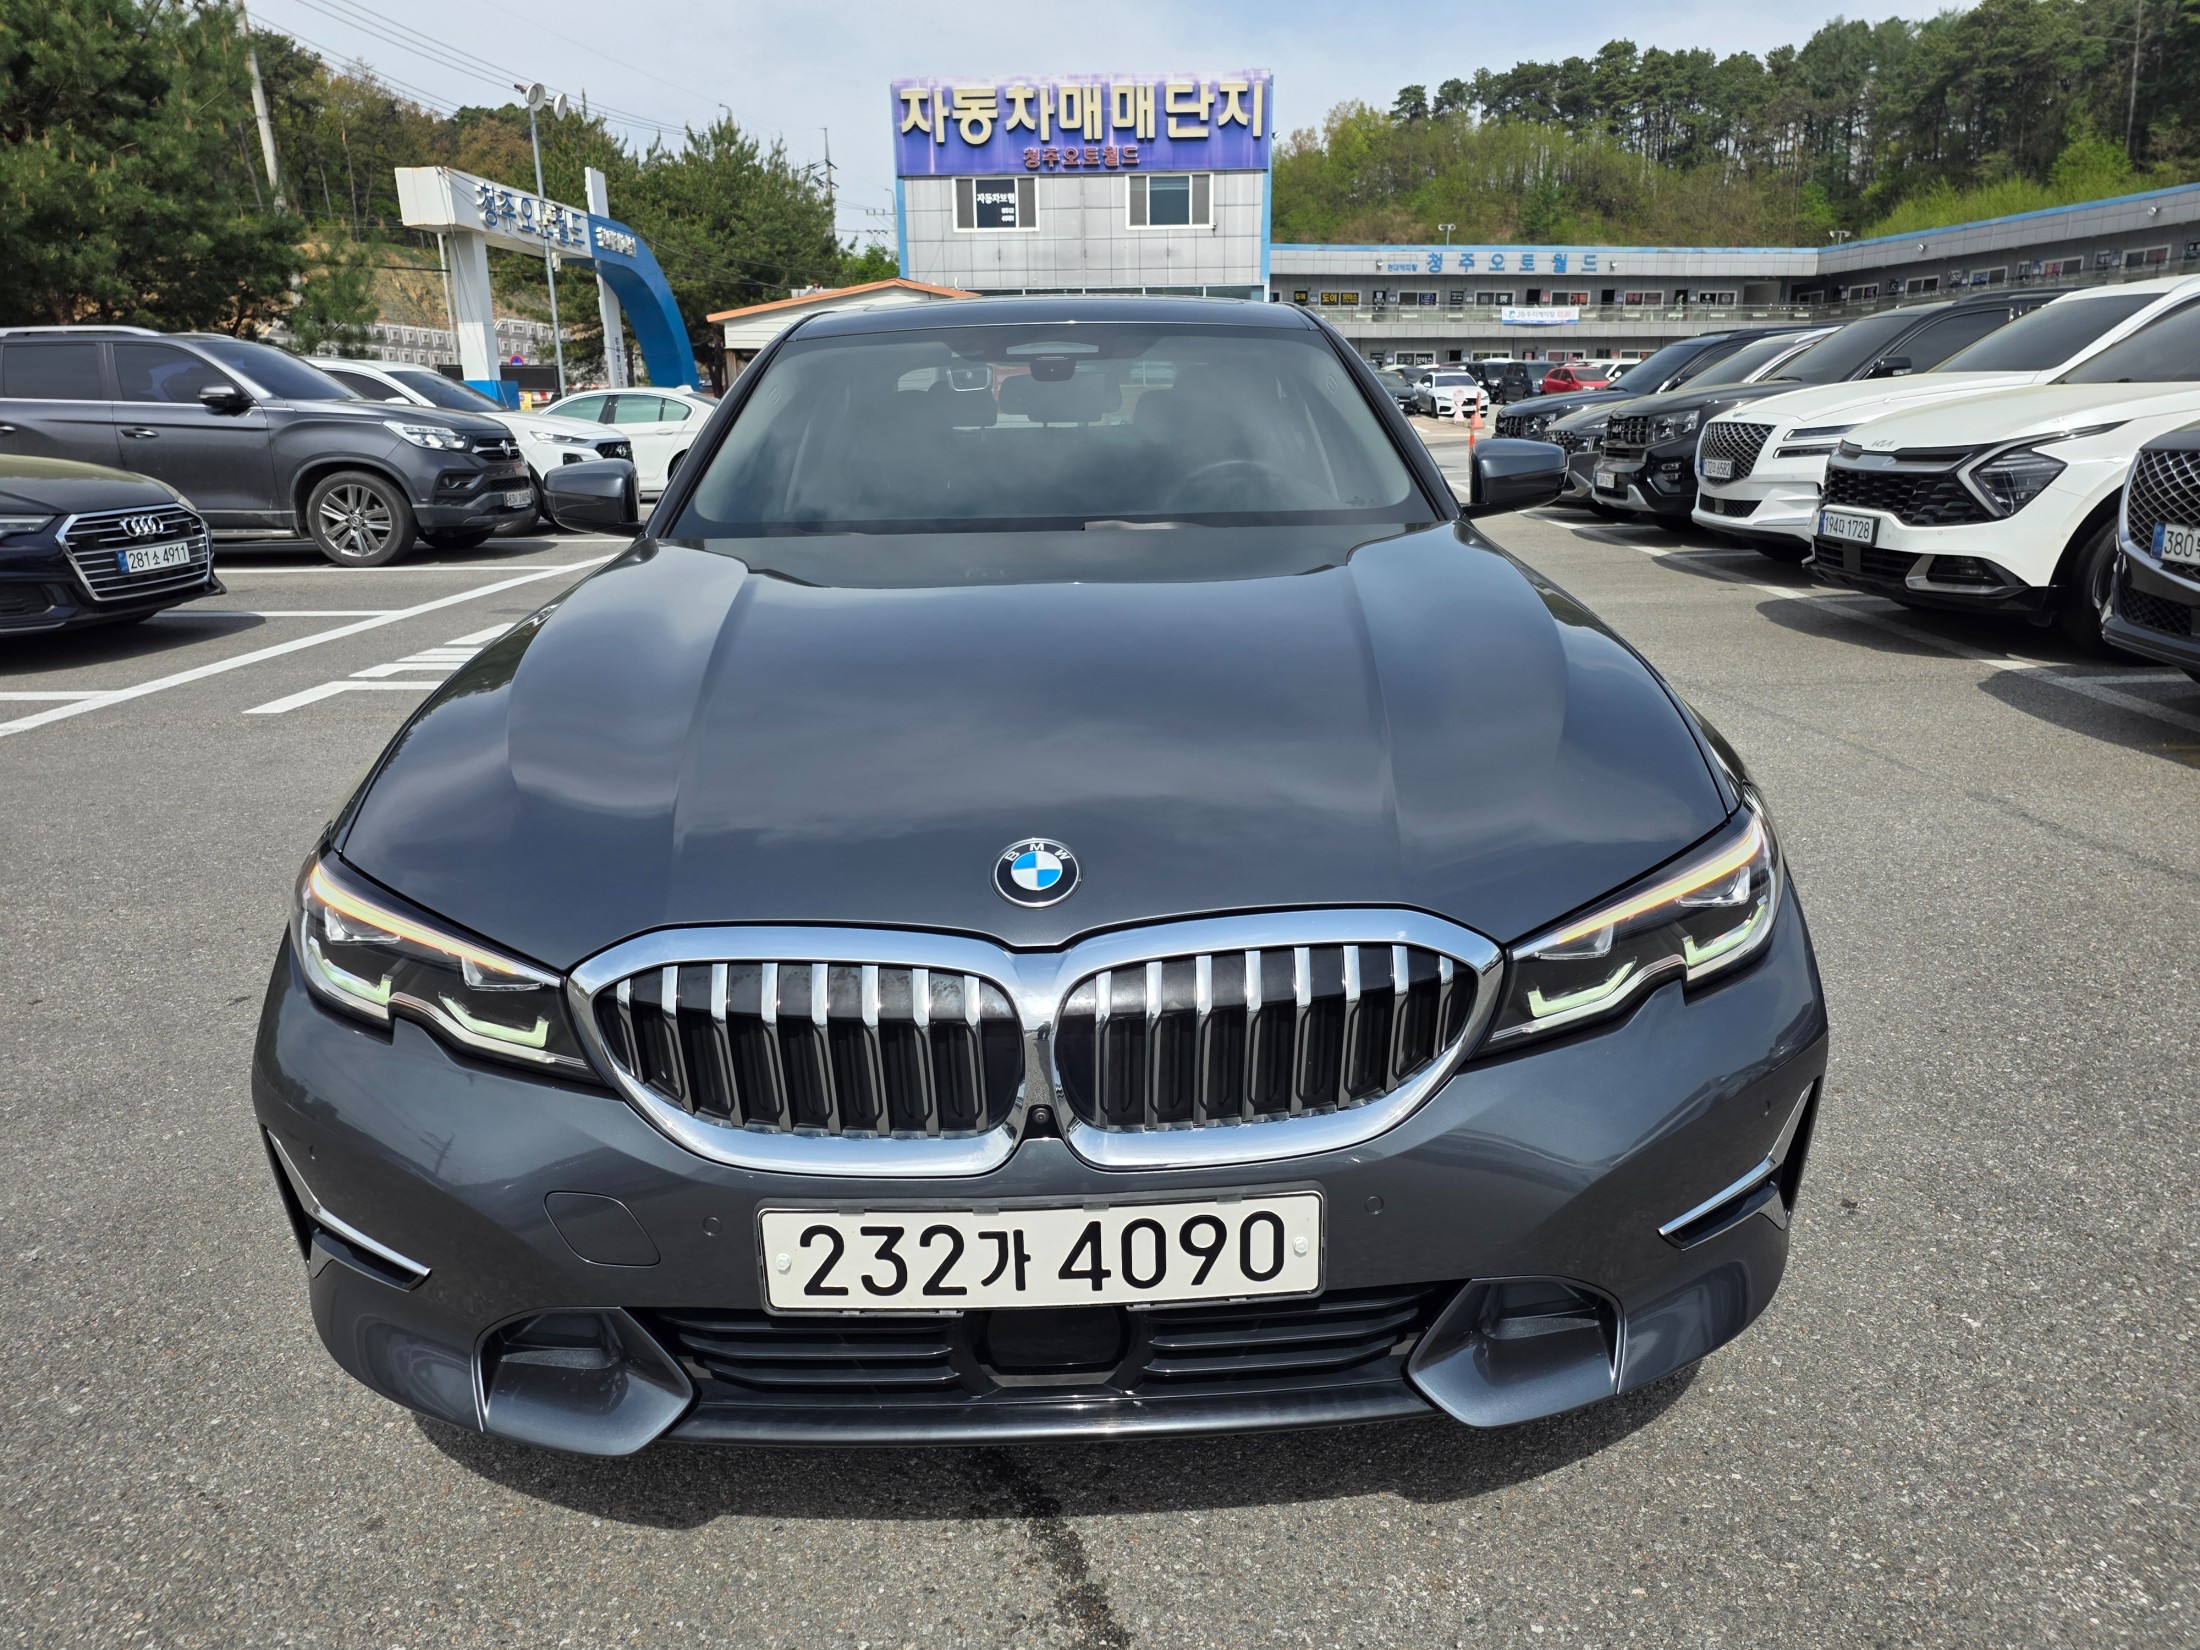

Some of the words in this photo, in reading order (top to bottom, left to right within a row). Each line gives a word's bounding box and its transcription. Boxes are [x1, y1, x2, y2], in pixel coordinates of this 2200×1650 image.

[900, 81, 1262, 145] 자동차매매단지
[1023, 146, 1140, 168] 청주오토월드
[1426, 252, 1597, 273] 청주오토월드
[1416, 356, 1433, 364] 모터스
[1848, 519, 1870, 540] 1728
[128, 550, 160, 569] 281소
[163, 545, 187, 564] 4911
[1004, 843, 1071, 862] BMW
[799, 1223, 1031, 1297] 232가
[1057, 1210, 1286, 1292] 4090
